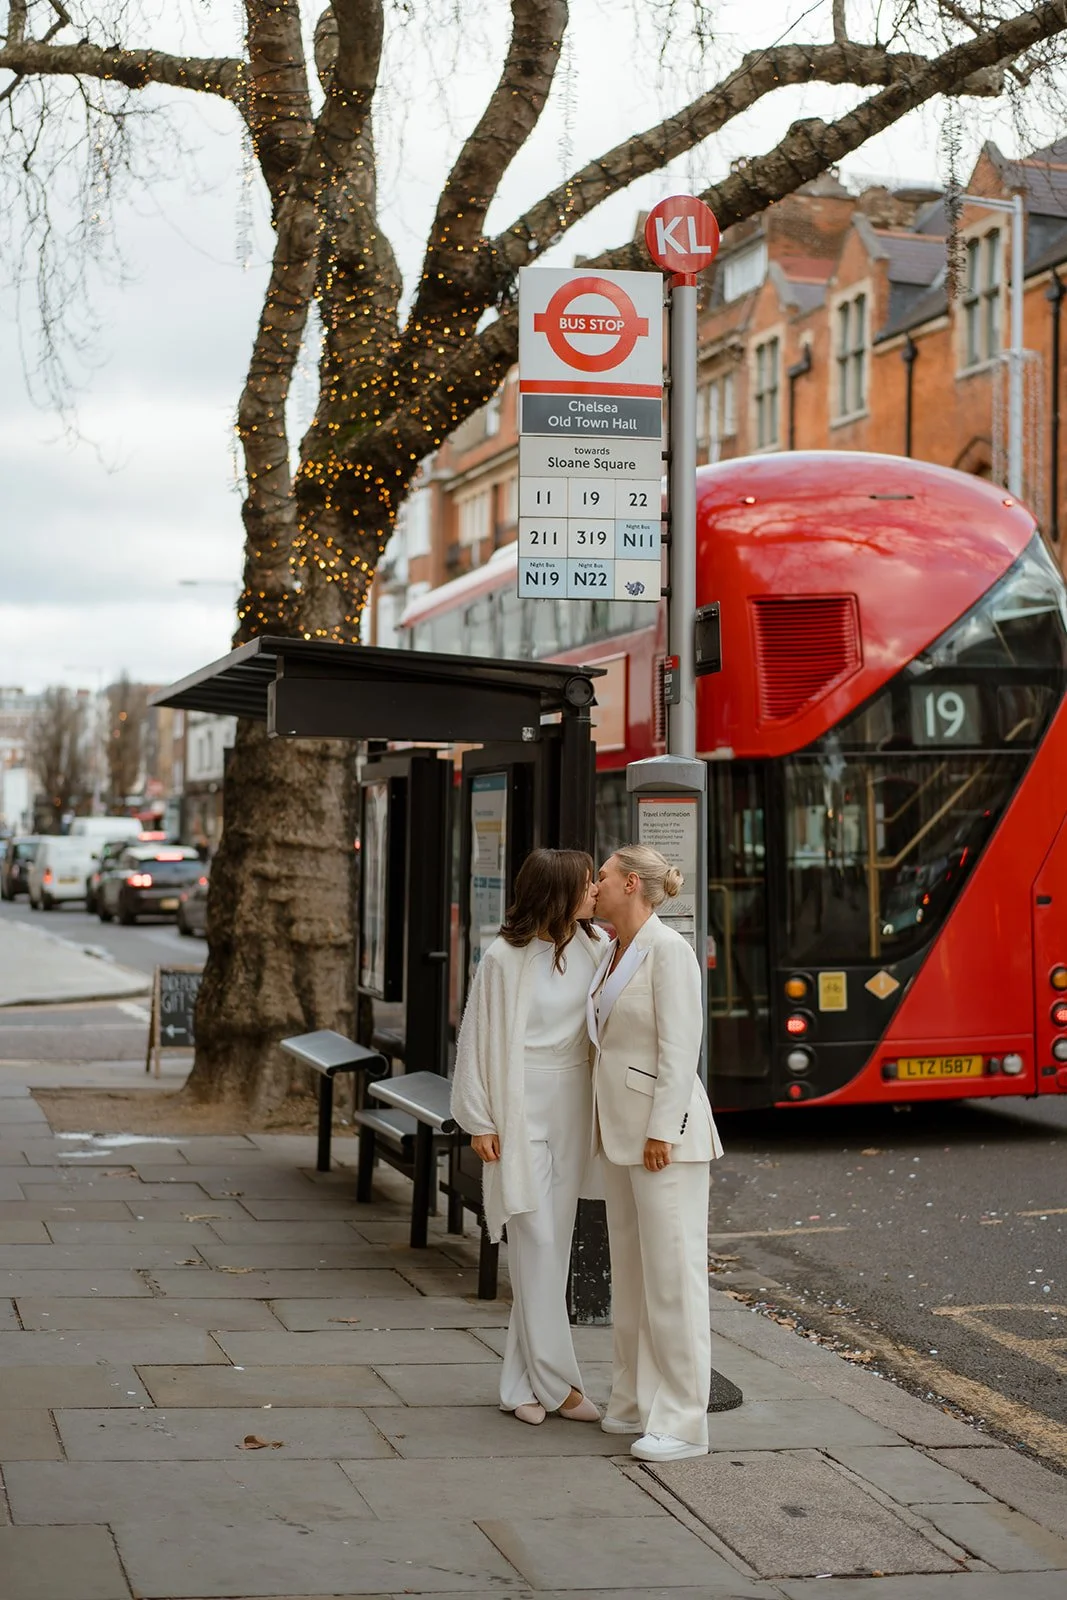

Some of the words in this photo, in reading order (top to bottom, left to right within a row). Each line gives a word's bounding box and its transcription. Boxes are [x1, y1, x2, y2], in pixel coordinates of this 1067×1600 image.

[655, 216, 712, 255] KL
[559, 318, 586, 330] BUS
[590, 319, 625, 331] STOP
[569, 401, 618, 413] Chelsea
[548, 416, 571, 427] Old
[575, 417, 608, 428] Town
[613, 418, 637, 430] Hall
[548, 457, 590, 468] Sloane
[594, 458, 635, 471] Square
[537, 491, 550, 504] 11
[583, 492, 599, 505] 19
[629, 493, 647, 507] 22
[530, 531, 557, 544] 211
[577, 531, 606, 544] 319
[624, 534, 653, 547] N11
[526, 572, 559, 585] N19
[575, 573, 607, 586] N22
[926, 691, 965, 737] 19
[906, 1060, 936, 1076] LTZ
[940, 1059, 973, 1073] 1587
